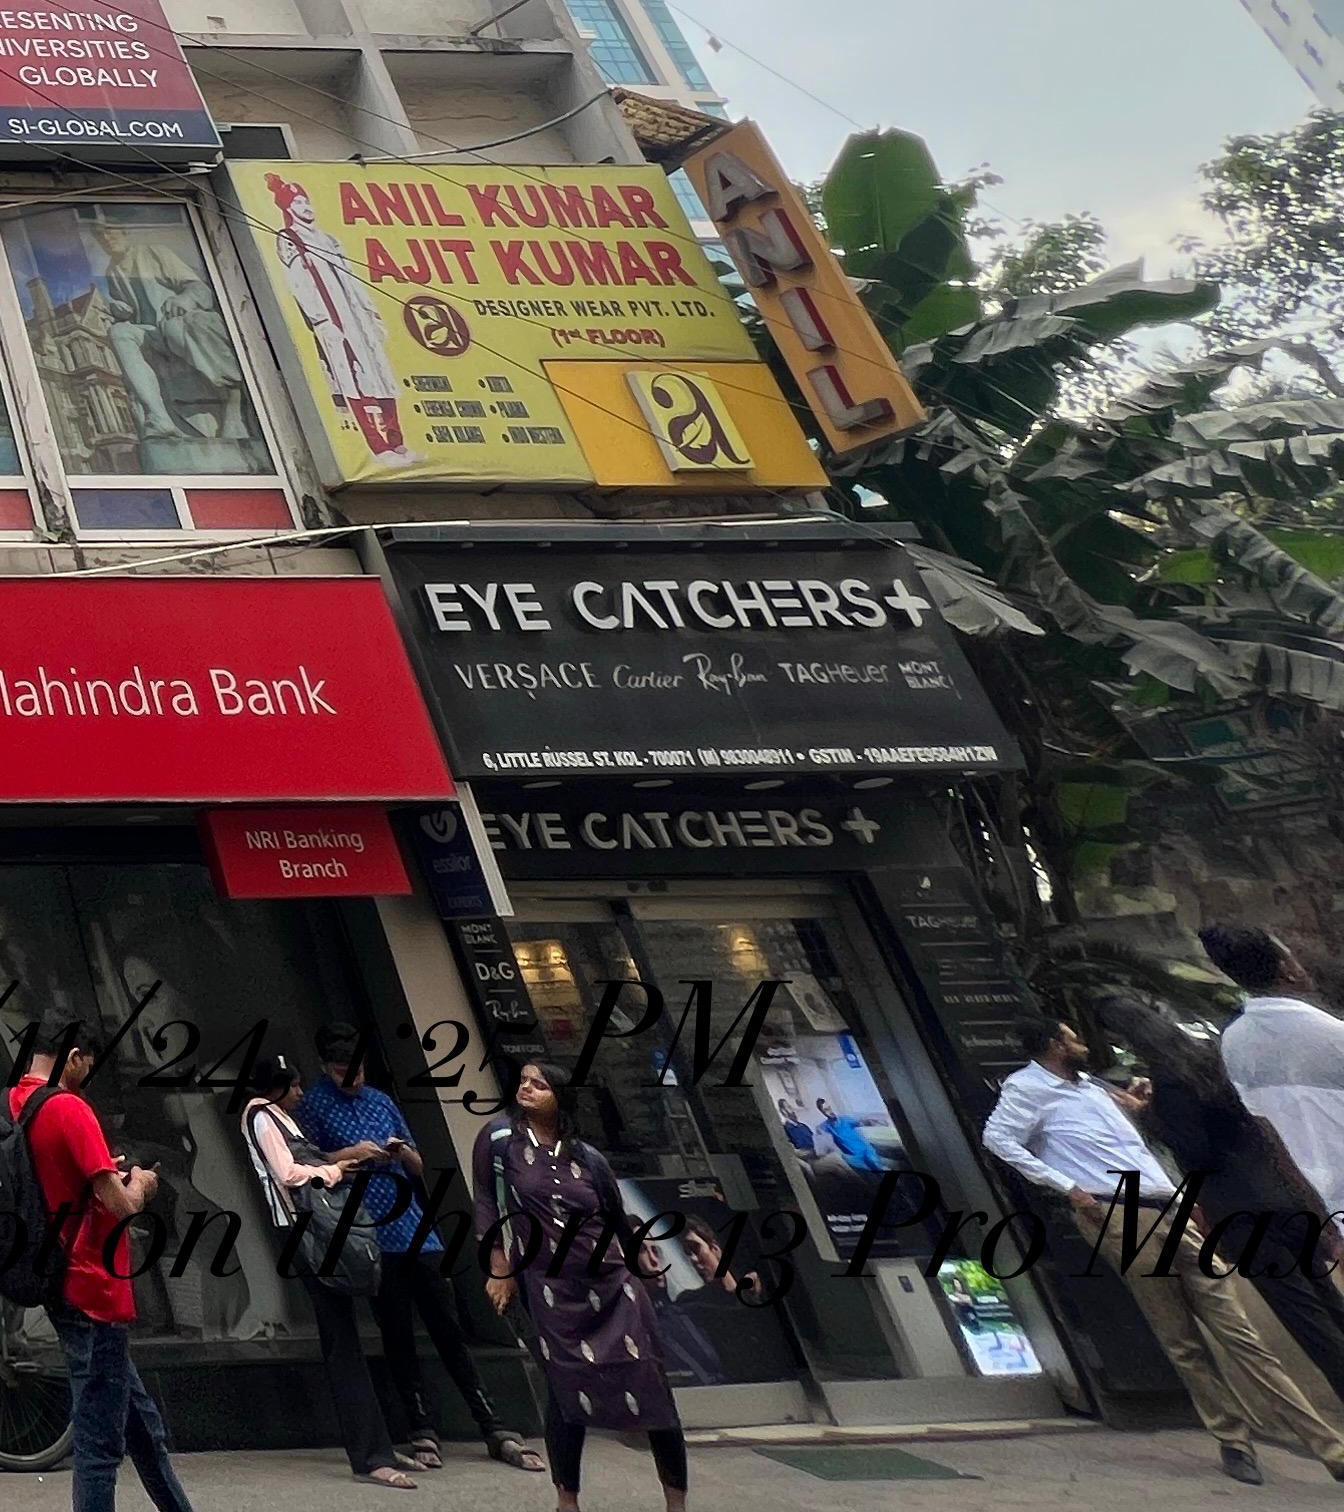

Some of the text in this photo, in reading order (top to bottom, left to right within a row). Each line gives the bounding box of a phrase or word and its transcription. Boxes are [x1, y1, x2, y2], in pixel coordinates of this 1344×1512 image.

[19, 65, 159, 88] GLOBALLY
[8, 117, 185, 141] SI-GLOBAL.COM
[338, 181, 670, 230] ANIL KUMAR
[366, 237, 699, 287] AJIT KUMAR
[702, 150, 897, 432] ANIL
[472, 299, 716, 318] DESIGNER WEAR PVT. LTD.
[587, 328, 666, 348] FLOOR)
[424, 581, 551, 632] EYE
[453, 661, 602, 690] VERSACE
[612, 664, 685, 689] Cartier
[898, 661, 941, 675] MONT
[217, 665, 337, 718] Bank
[482, 752, 499, 772] 6,
[496, 751, 542, 769] LITTLE
[544, 749, 594, 768] RUSSEL
[595, 750, 612, 768] ST.
[614, 750, 643, 767] KOL
[650, 749, 696, 767] 700071
[809, 747, 857, 764] GSTIN
[244, 827, 365, 854] NRI Banking
[483, 811, 574, 852] EYE
[583, 808, 835, 851] CATCHERS
[278, 857, 349, 879] Branch
[474, 962, 516, 982] D&G
